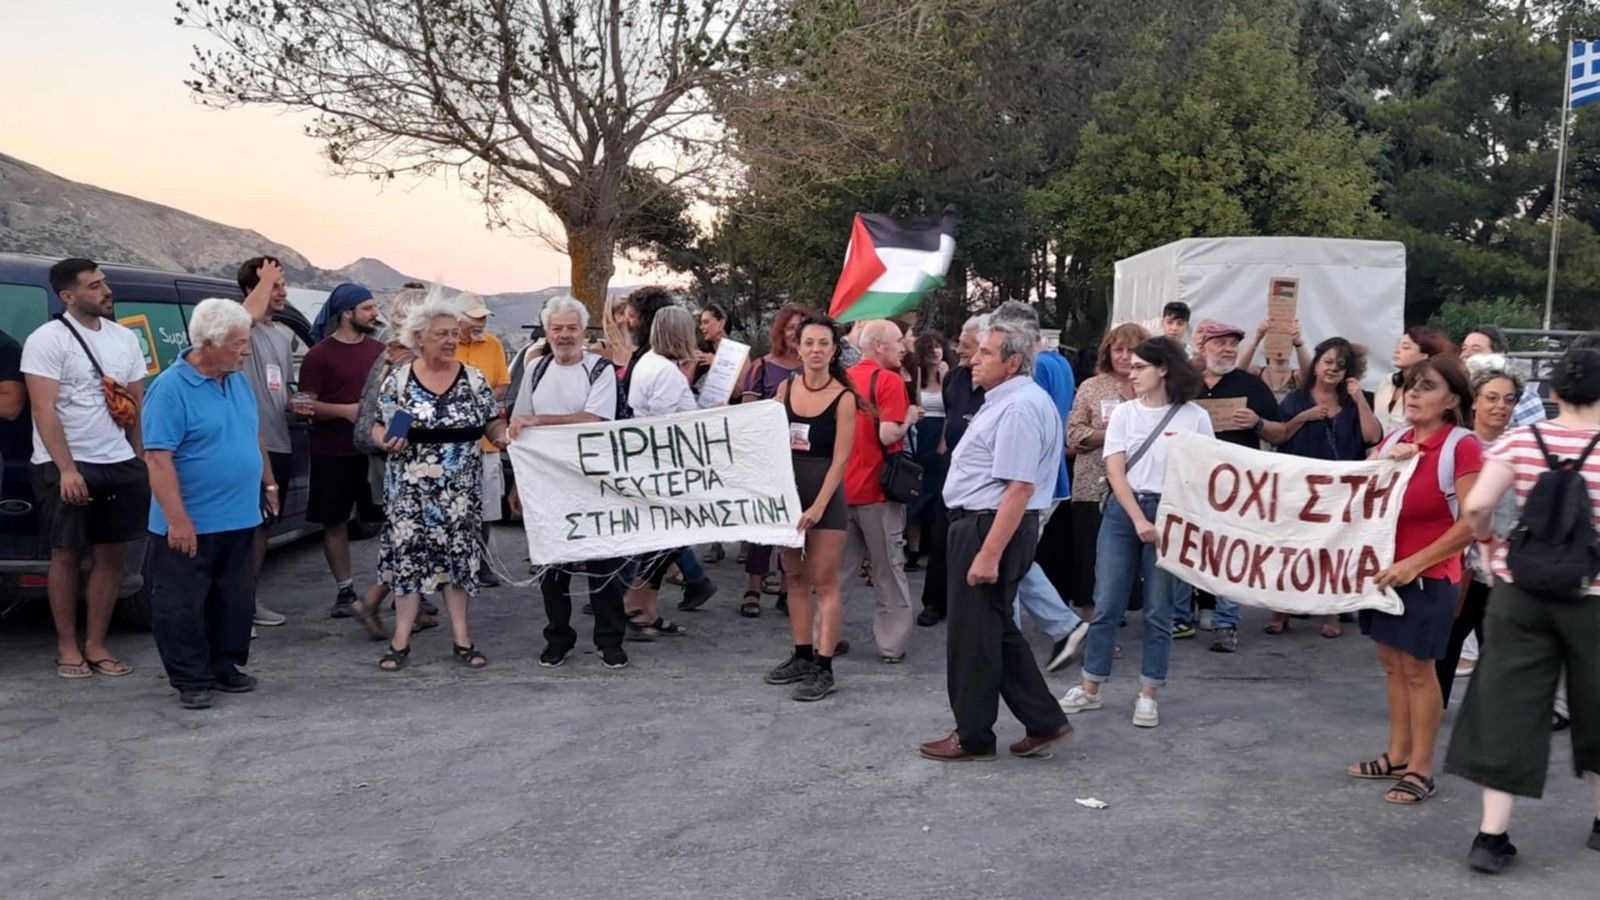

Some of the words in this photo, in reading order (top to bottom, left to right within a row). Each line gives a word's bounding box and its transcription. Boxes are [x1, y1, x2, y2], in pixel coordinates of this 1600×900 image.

[577, 416, 734, 476] ΕΙΡΗΝΗ
[600, 468, 724, 498] ΛΕΥΤΕΡΙΑ
[1208, 463, 1278, 522] ΟΧΙ
[1299, 471, 1401, 523] ΣΤΗ
[565, 506, 639, 540] ΣΤΗΝ
[650, 494, 790, 531] ΠΑΛΑΙΣΤΙΝΗ
[1161, 513, 1382, 594] ΓΕΝΟΚΤΟΝΙΑ
